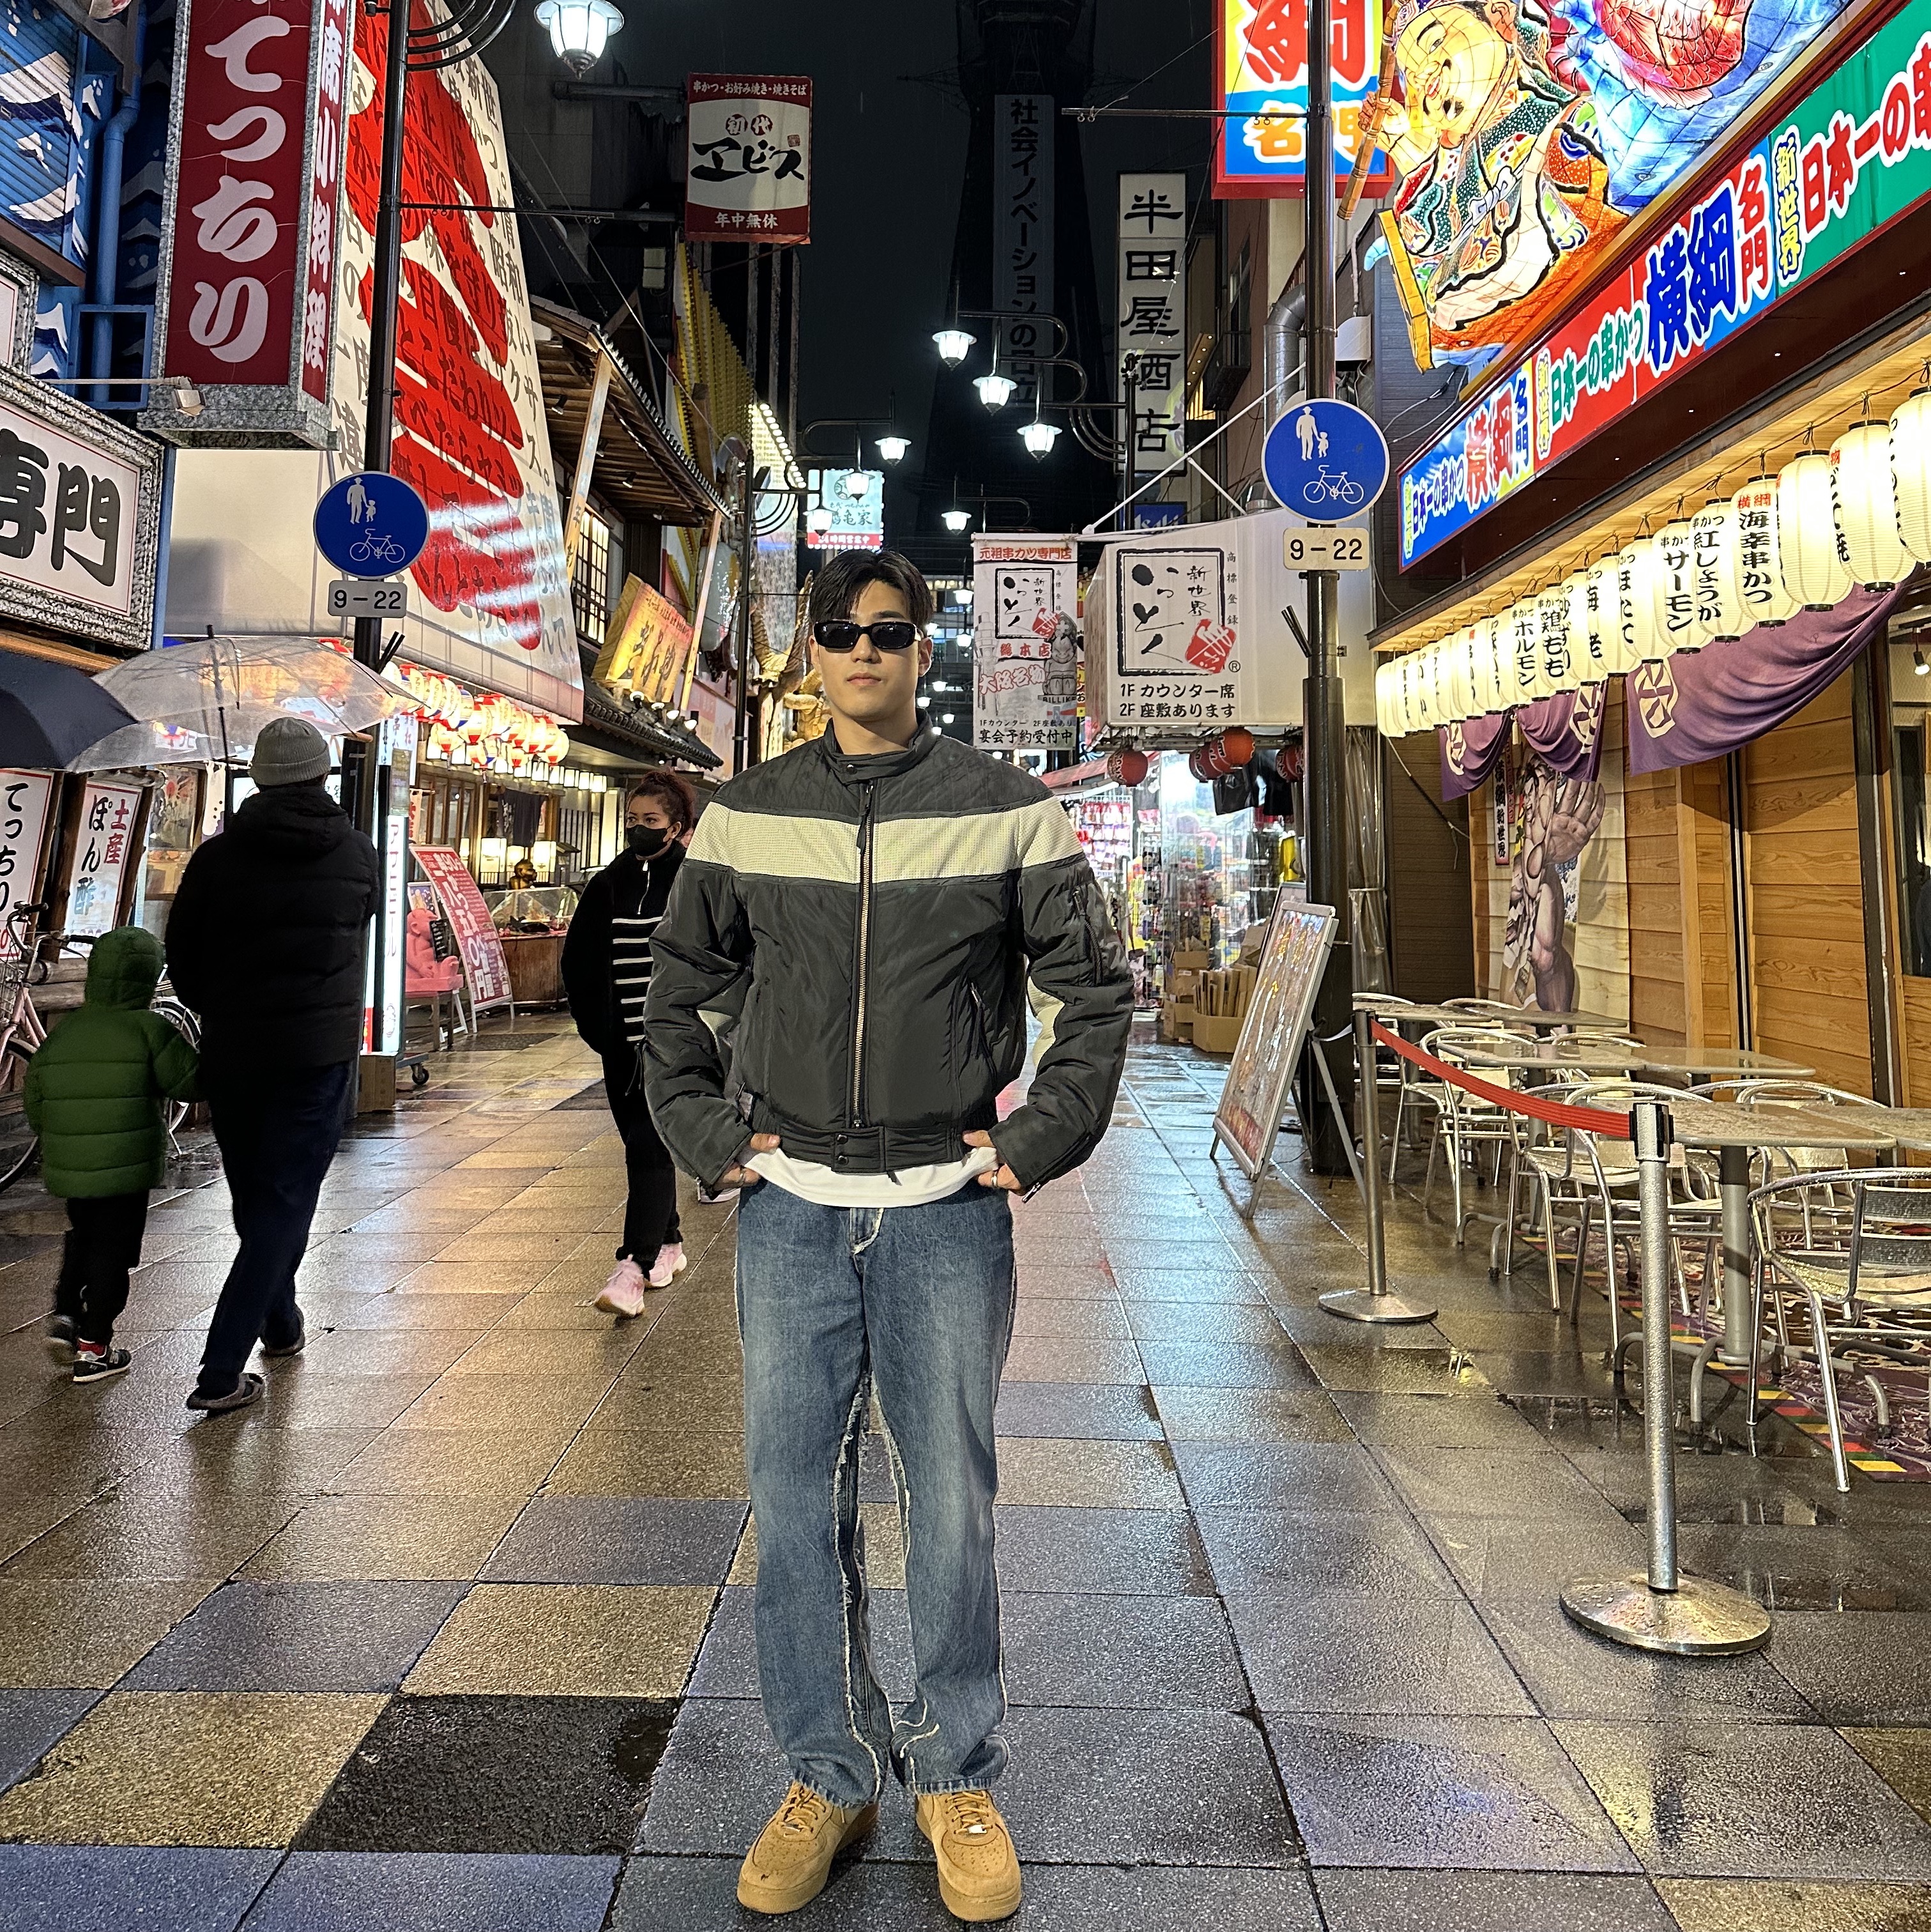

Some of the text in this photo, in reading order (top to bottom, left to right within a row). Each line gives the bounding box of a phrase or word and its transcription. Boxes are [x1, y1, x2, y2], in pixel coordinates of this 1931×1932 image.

[726, 114, 772, 135] 初代
[715, 211, 778, 229] 年中無休
[1739, 164, 1769, 303] 名門
[1776, 133, 1801, 280] 新世界
[1647, 187, 1736, 371] 横綱
[1552, 309, 1643, 426] 日本一の串かつ
[1467, 388, 1513, 505] 横綱
[1515, 378, 1529, 475] 名門
[1413, 458, 1465, 535] 日本一の串かつ
[1737, 493, 1771, 509] 横綱
[980, 548, 1072, 560] 元祖串カツ専門店
[1290, 537, 1363, 560] 9-22
[1694, 531, 1723, 622] 紅しょうが
[333, 589, 402, 611] 9-22
[1227, 552, 1239, 625] 商標登録
[1663, 550, 1693, 632] サーモン
[979, 663, 1046, 695] 大阪名物
[1514, 620, 1536, 687] ホルモン
[1120, 683, 1235, 698] 1F カウンター席
[1120, 702, 1236, 718] 2F 座敷あります
[979, 728, 1073, 744] 宴会予約受付中
[73, 794, 113, 916] ぽん酢
[103, 799, 130, 864] 土産
